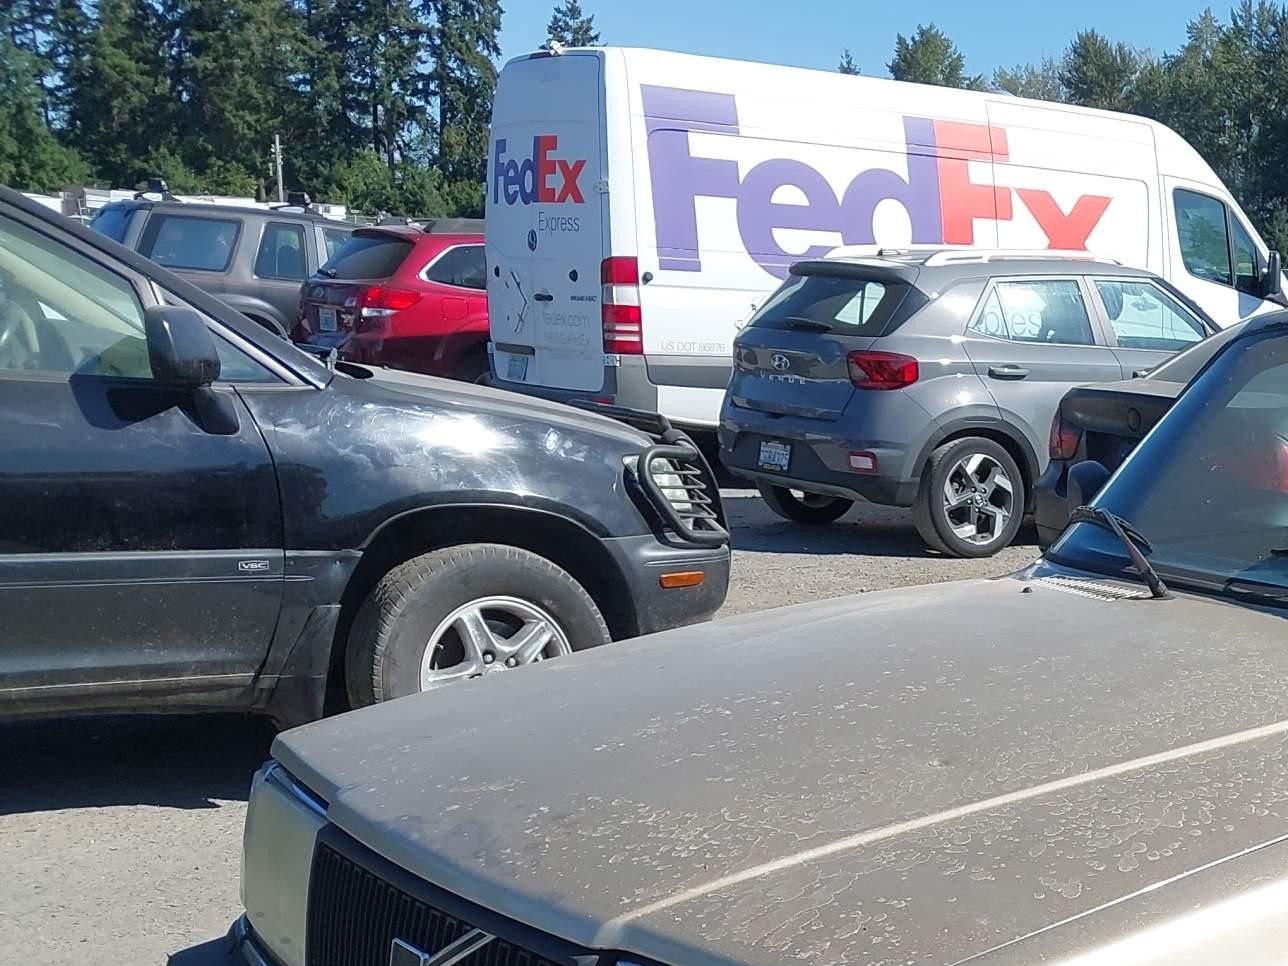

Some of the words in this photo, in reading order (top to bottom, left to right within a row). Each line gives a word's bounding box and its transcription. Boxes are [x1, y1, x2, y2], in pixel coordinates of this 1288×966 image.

[493, 134, 587, 206] FedEx
[538, 211, 580, 234] Express
[661, 340, 675, 351] US
[676, 341, 697, 352] DOT
